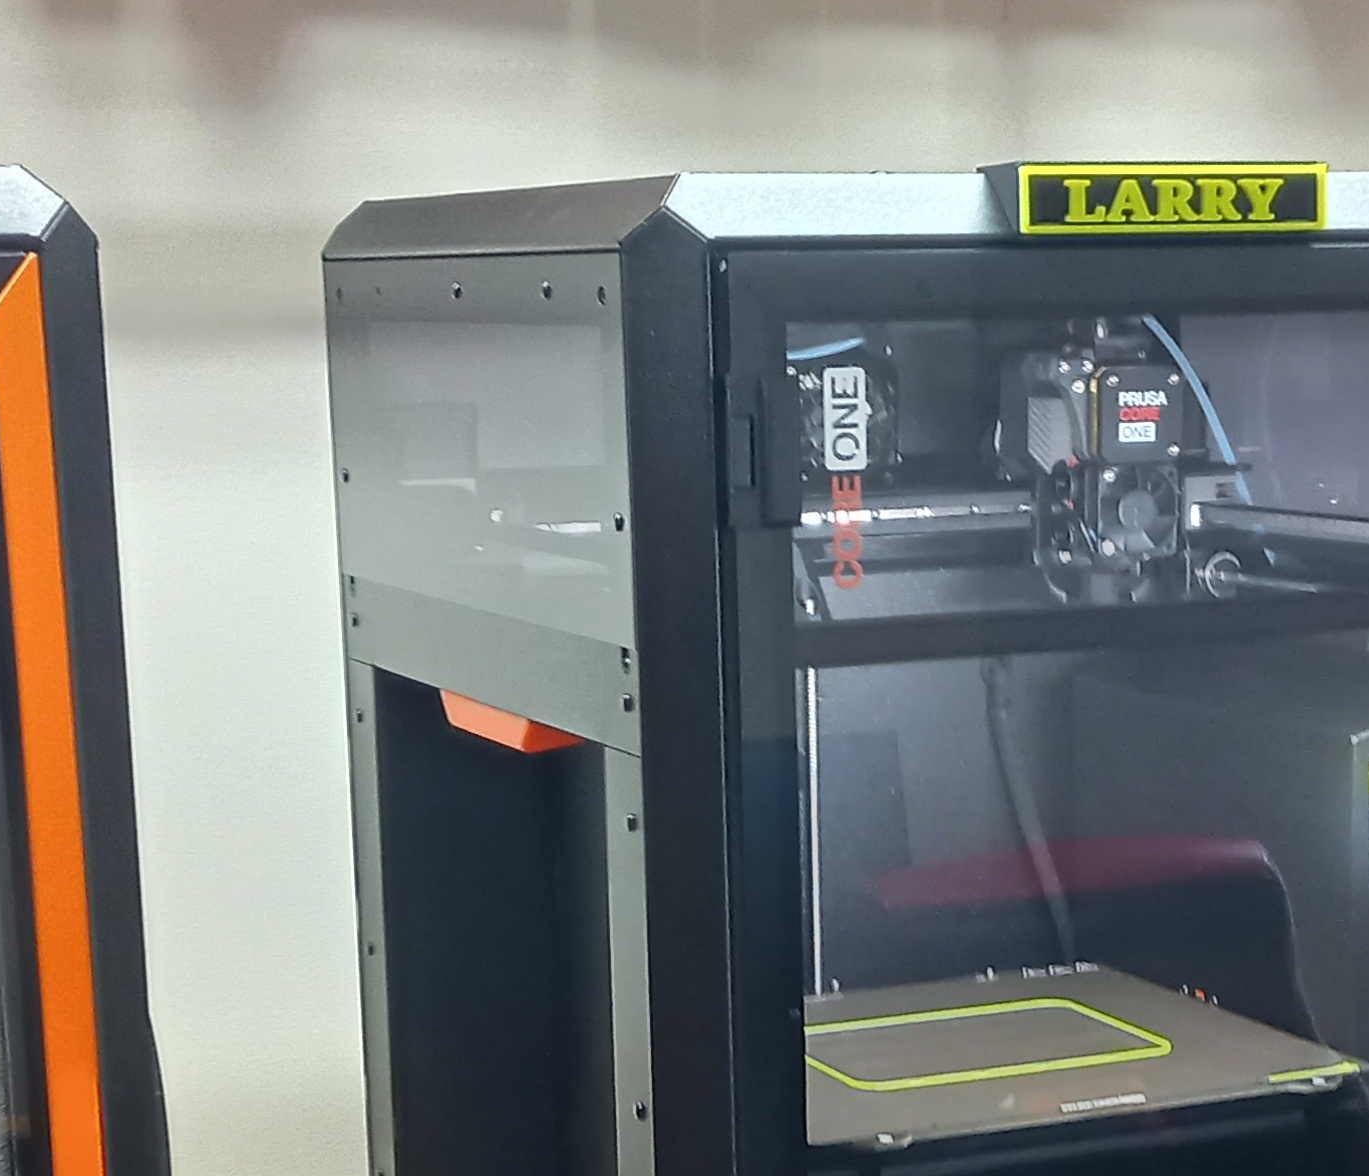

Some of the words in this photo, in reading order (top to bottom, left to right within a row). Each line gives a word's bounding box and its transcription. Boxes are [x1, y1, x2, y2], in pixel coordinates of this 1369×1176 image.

[1063, 178, 1284, 222] LARRY
[1118, 390, 1169, 406] PRUSA
[831, 375, 861, 462] ONE
[1122, 425, 1152, 439] ONE
